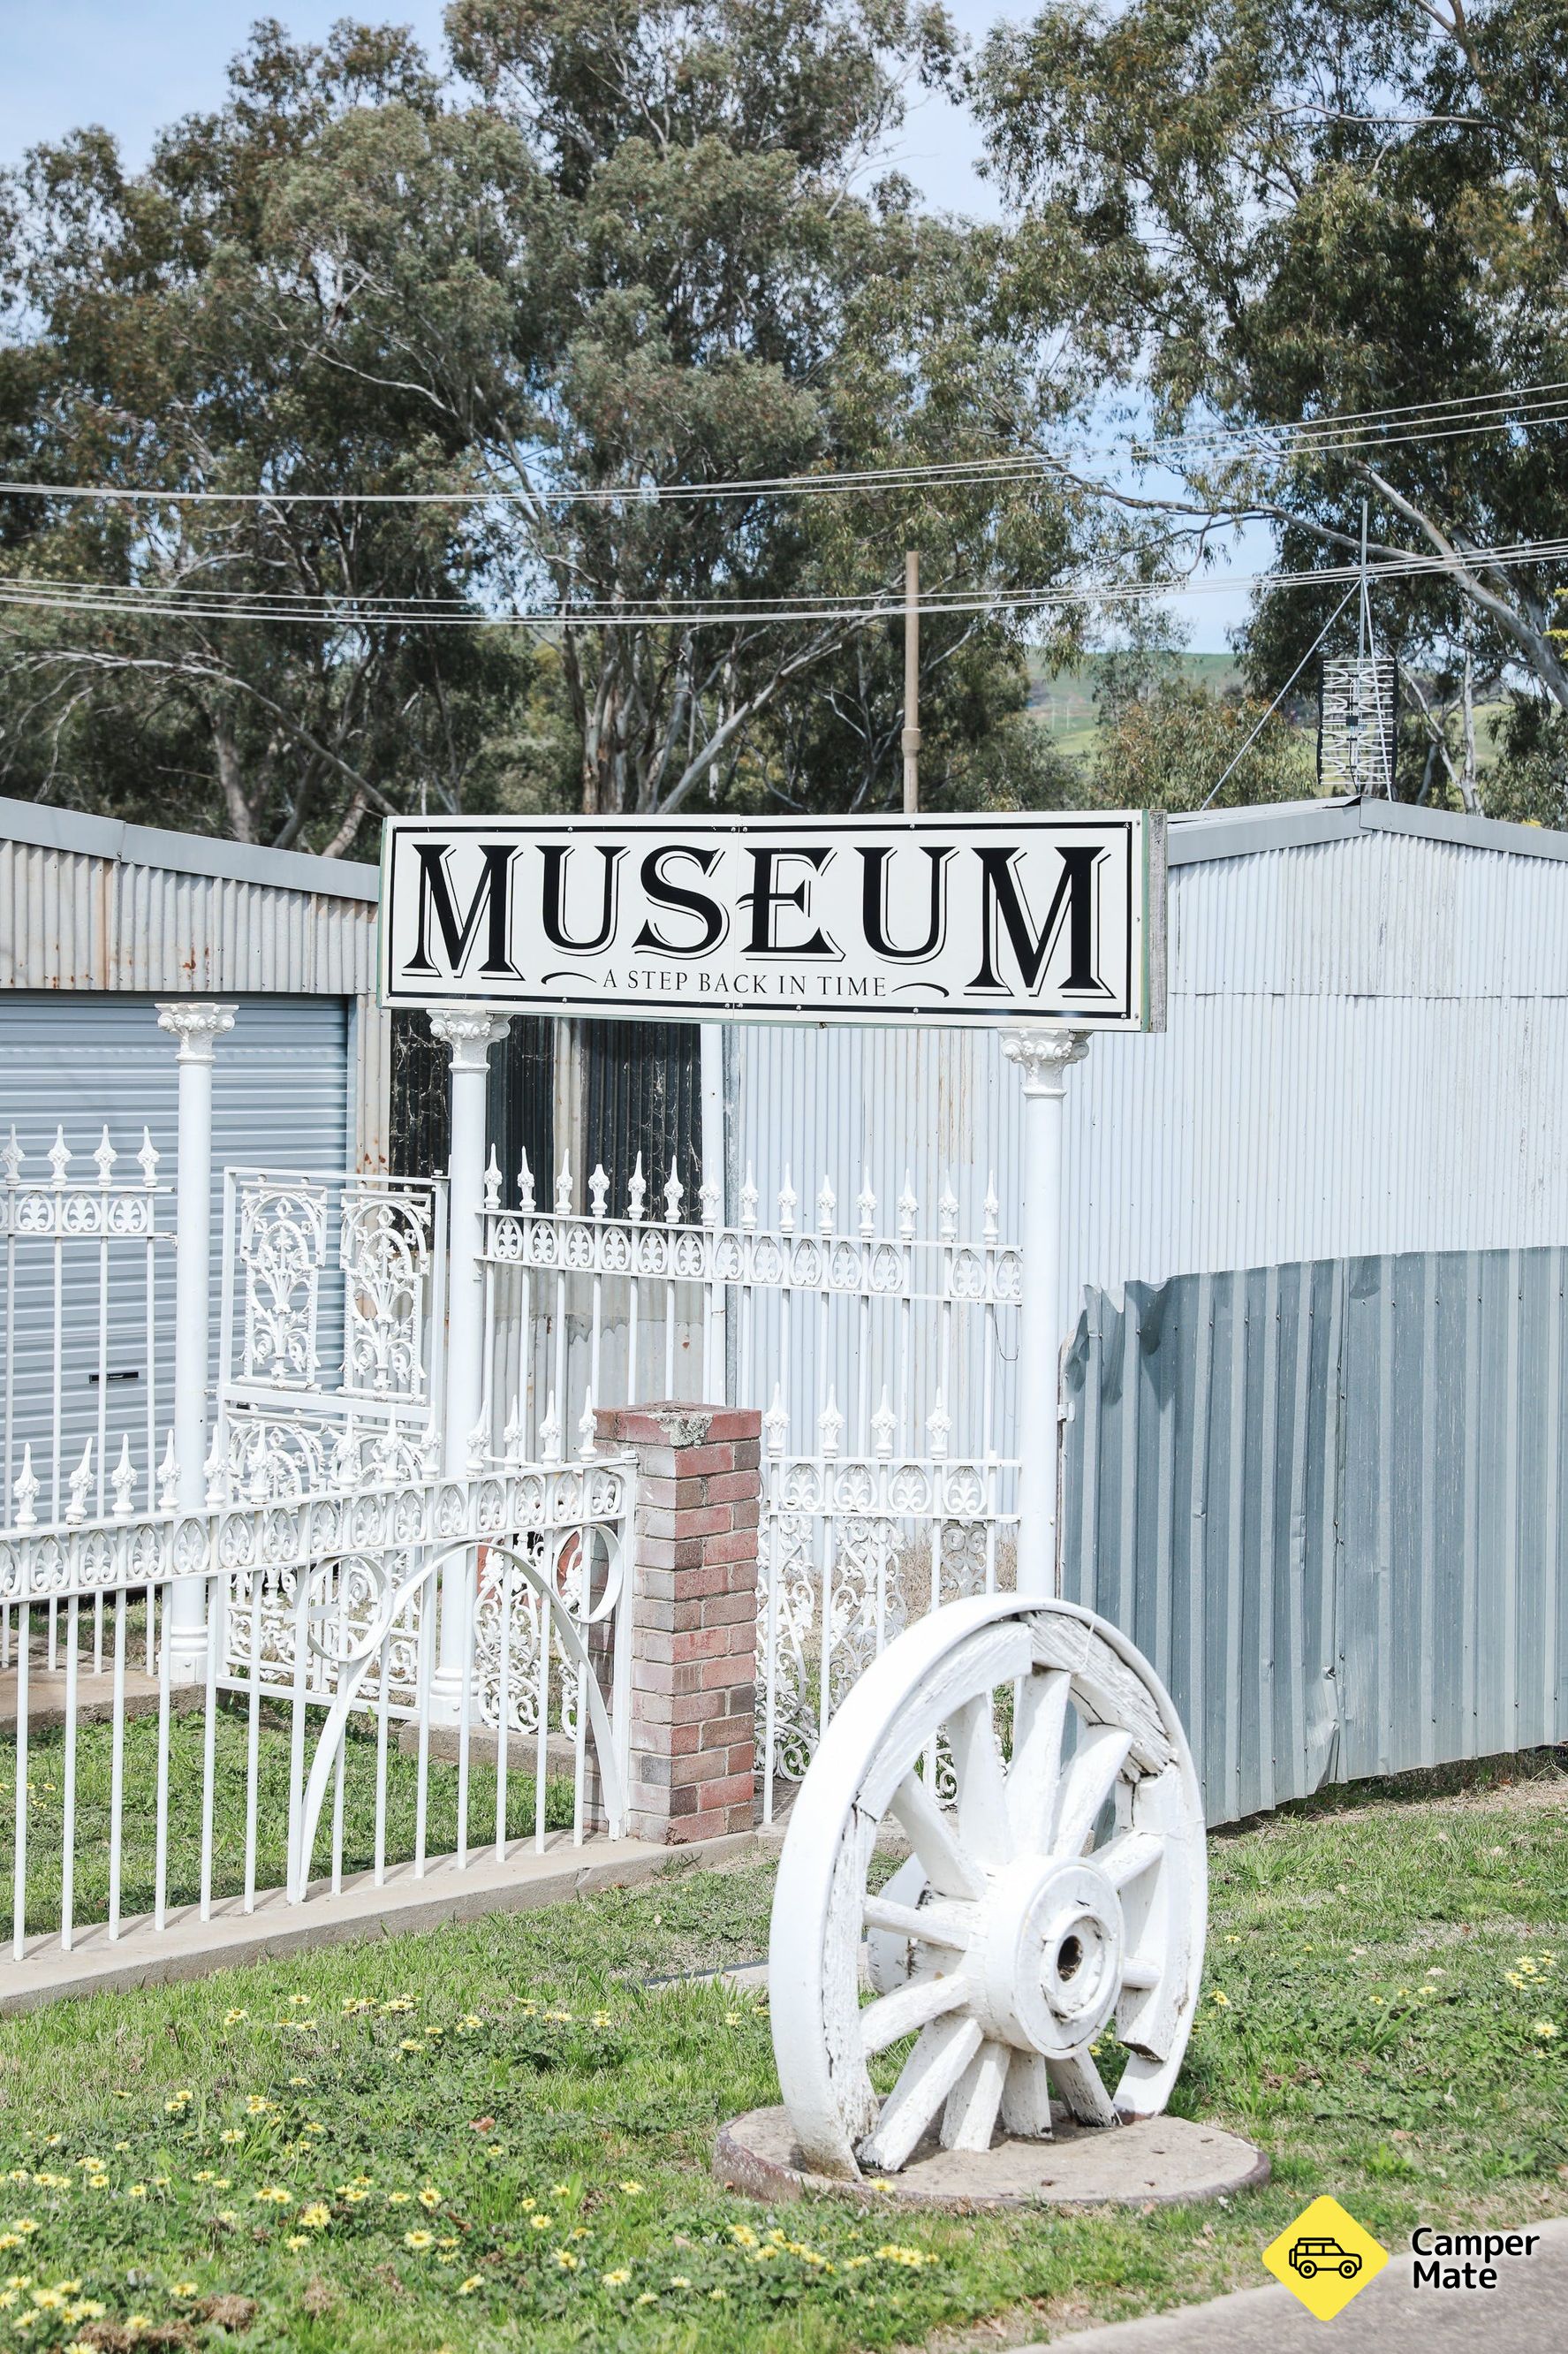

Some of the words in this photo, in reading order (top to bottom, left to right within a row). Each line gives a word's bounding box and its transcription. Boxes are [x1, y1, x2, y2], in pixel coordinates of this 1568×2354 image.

[402, 842, 1116, 999] MUSEUM
[602, 968, 617, 989] A
[627, 969, 688, 991] STEP
[698, 973, 768, 994] BACK
[778, 975, 807, 995] IN
[817, 976, 887, 997] TIME
